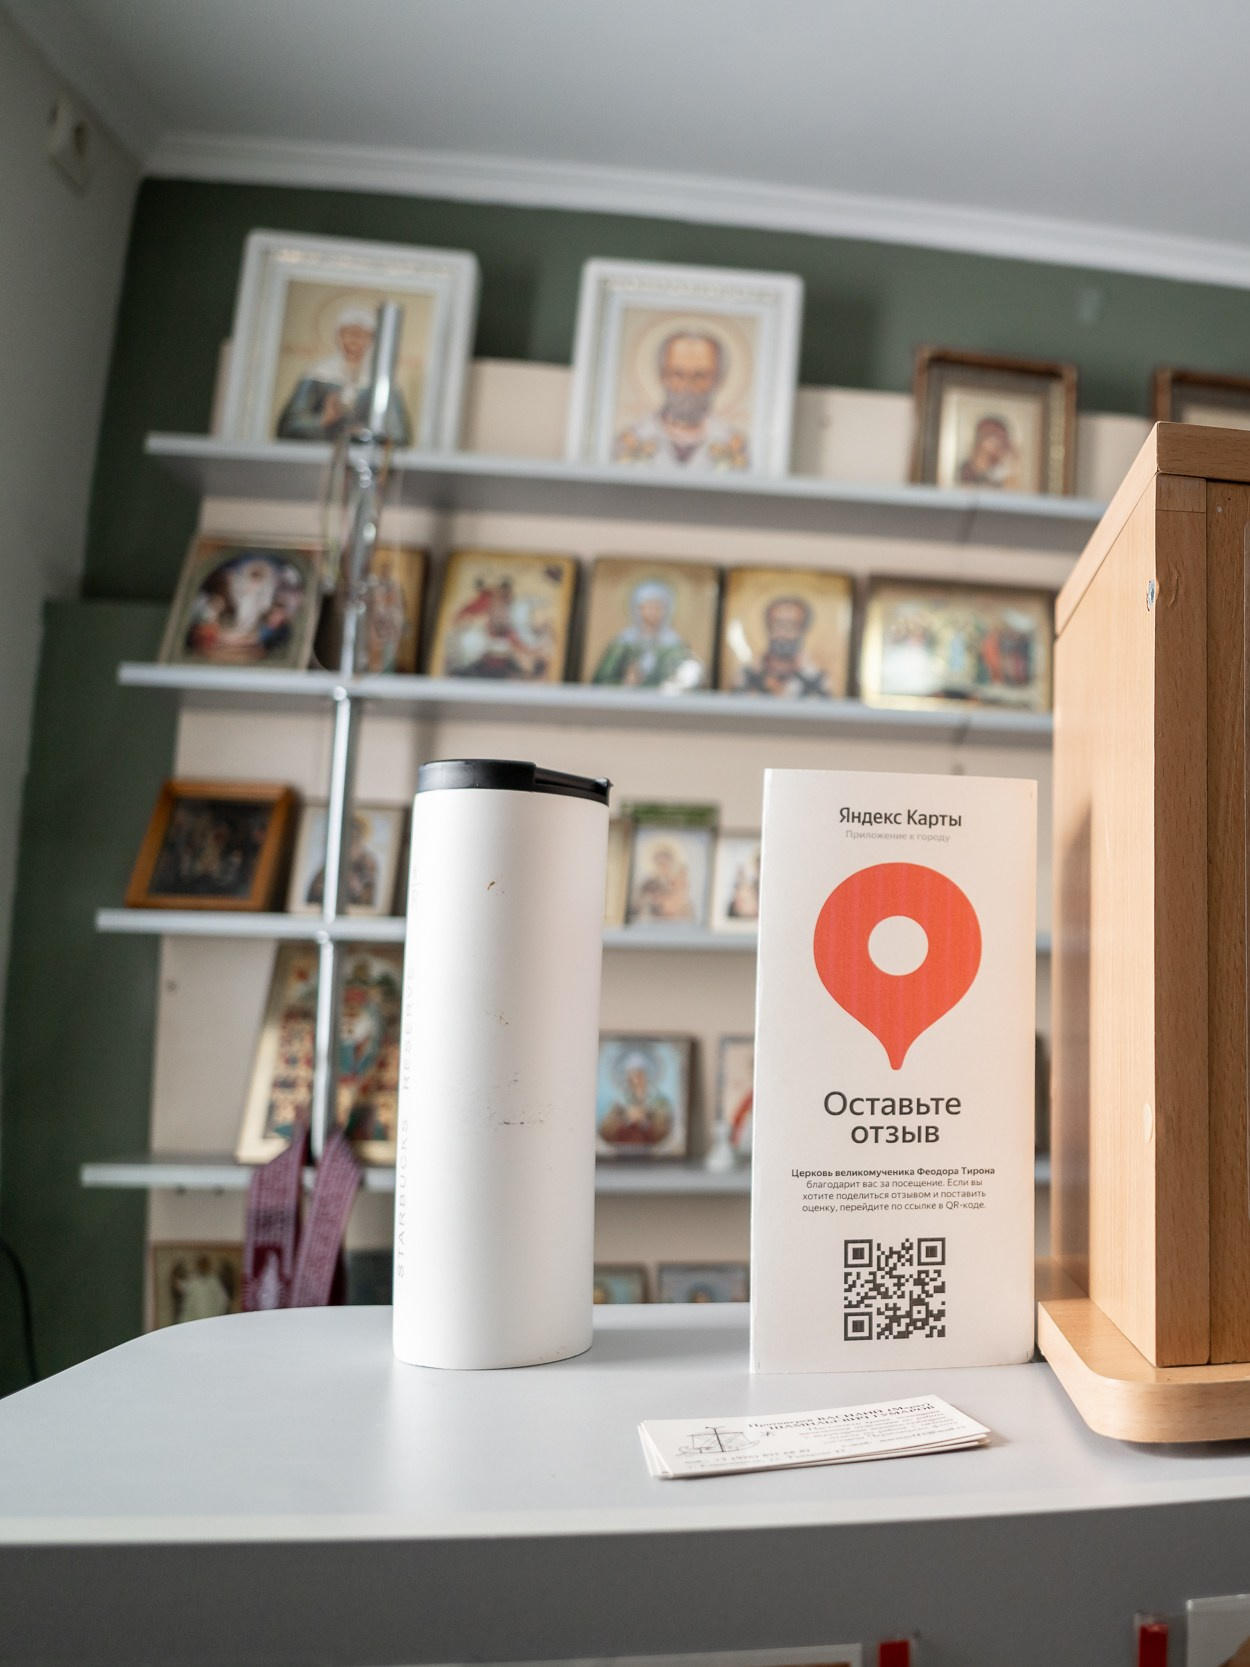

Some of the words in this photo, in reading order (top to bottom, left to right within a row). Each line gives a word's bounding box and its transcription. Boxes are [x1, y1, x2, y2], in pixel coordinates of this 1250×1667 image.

[839, 807, 902, 826] Яндекс
[907, 809, 962, 829] Карты
[845, 830, 907, 841] Приложение
[916, 834, 951, 843] городу
[403, 967, 415, 1091] RESERVE
[824, 1091, 962, 1116] Оставьте
[851, 1125, 940, 1144] отзыв
[791, 1169, 833, 1178] Церковь
[835, 1169, 915, 1178] великомученика
[917, 1167, 959, 1177] Феодора
[961, 1167, 995, 1176] Тирона
[806, 1179, 861, 1190] благодарит
[892, 1180, 945, 1189] посещение.
[947, 1178, 969, 1187] Если
[398, 1118, 409, 1279] STARBUCKS
[803, 1192, 834, 1200] хотите
[836, 1192, 889, 1201] поделиться
[891, 1191, 931, 1199] отзывом
[941, 1190, 986, 1198] поставить
[802, 1203, 838, 1213] оценку,
[840, 1202, 888, 1212] перейдите
[891, 1202, 903, 1210] по
[904, 1202, 937, 1210] ссылке
[945, 1201, 987, 1211] QR-коде.
